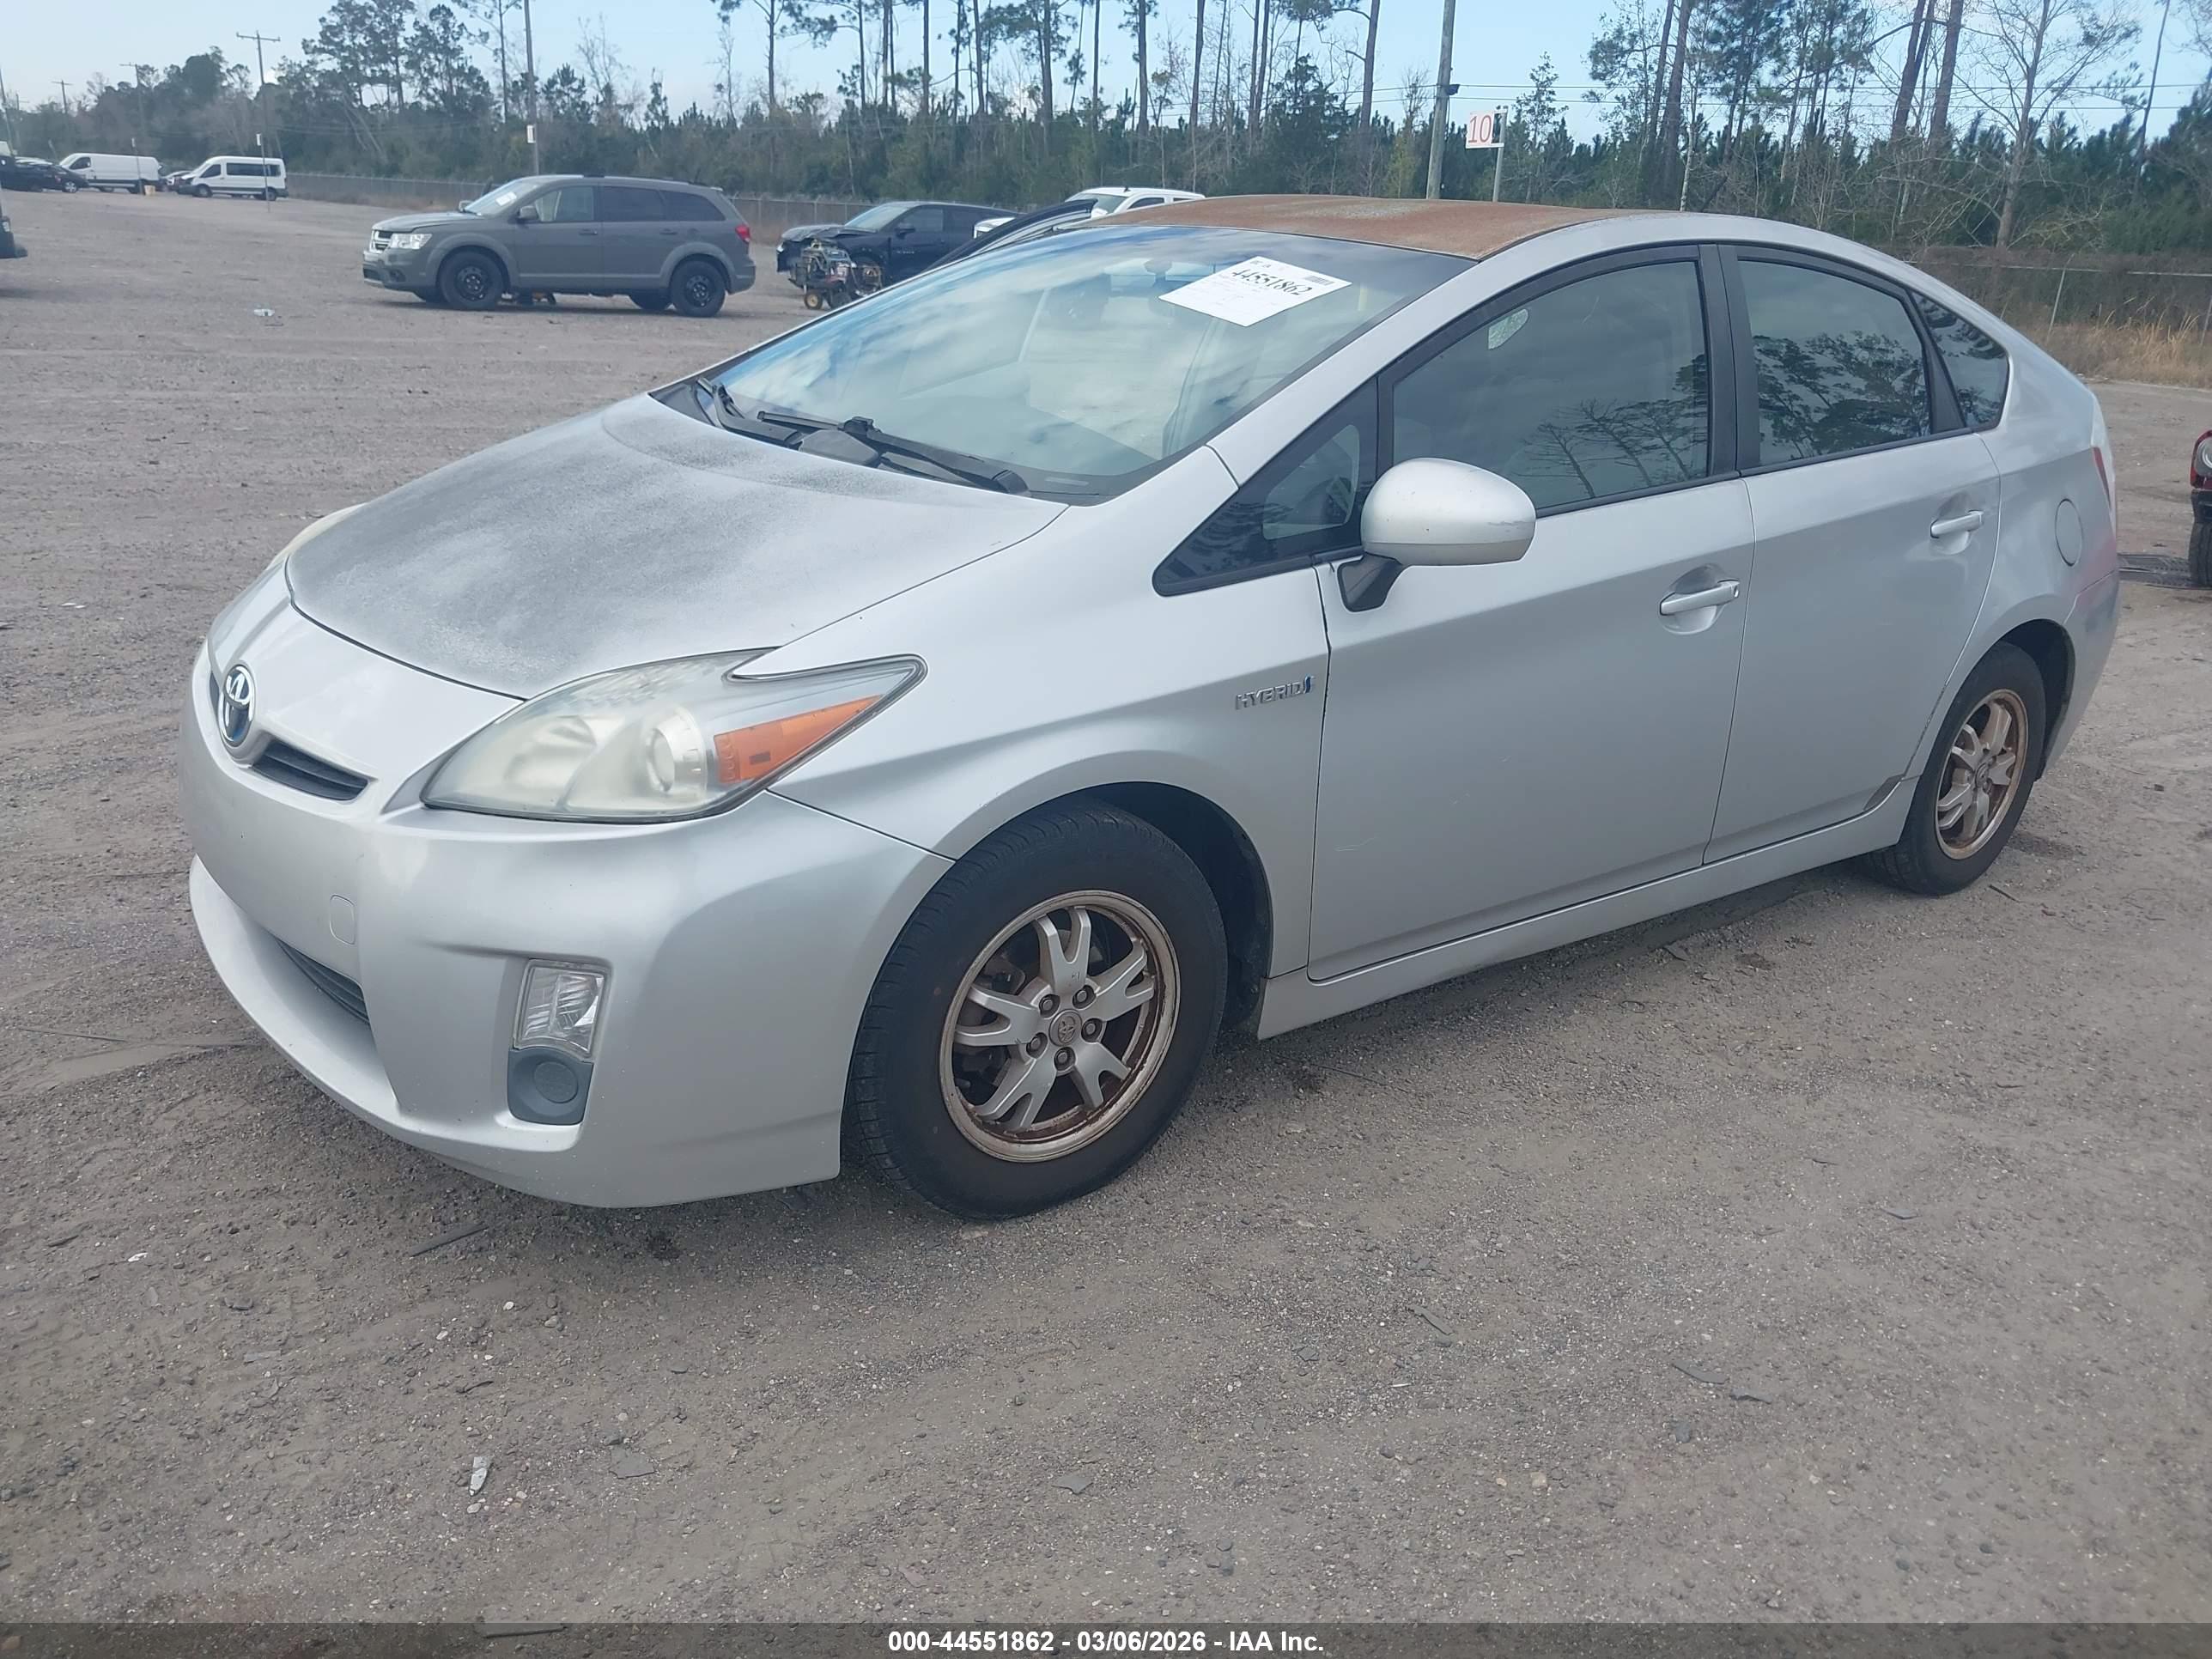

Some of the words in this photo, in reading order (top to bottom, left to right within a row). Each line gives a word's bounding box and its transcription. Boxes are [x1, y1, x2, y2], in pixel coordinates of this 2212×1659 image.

[1468, 114, 1492, 143] 10
[1231, 269, 1313, 295] 44551862
[1235, 681, 1304, 710] HYBRID
